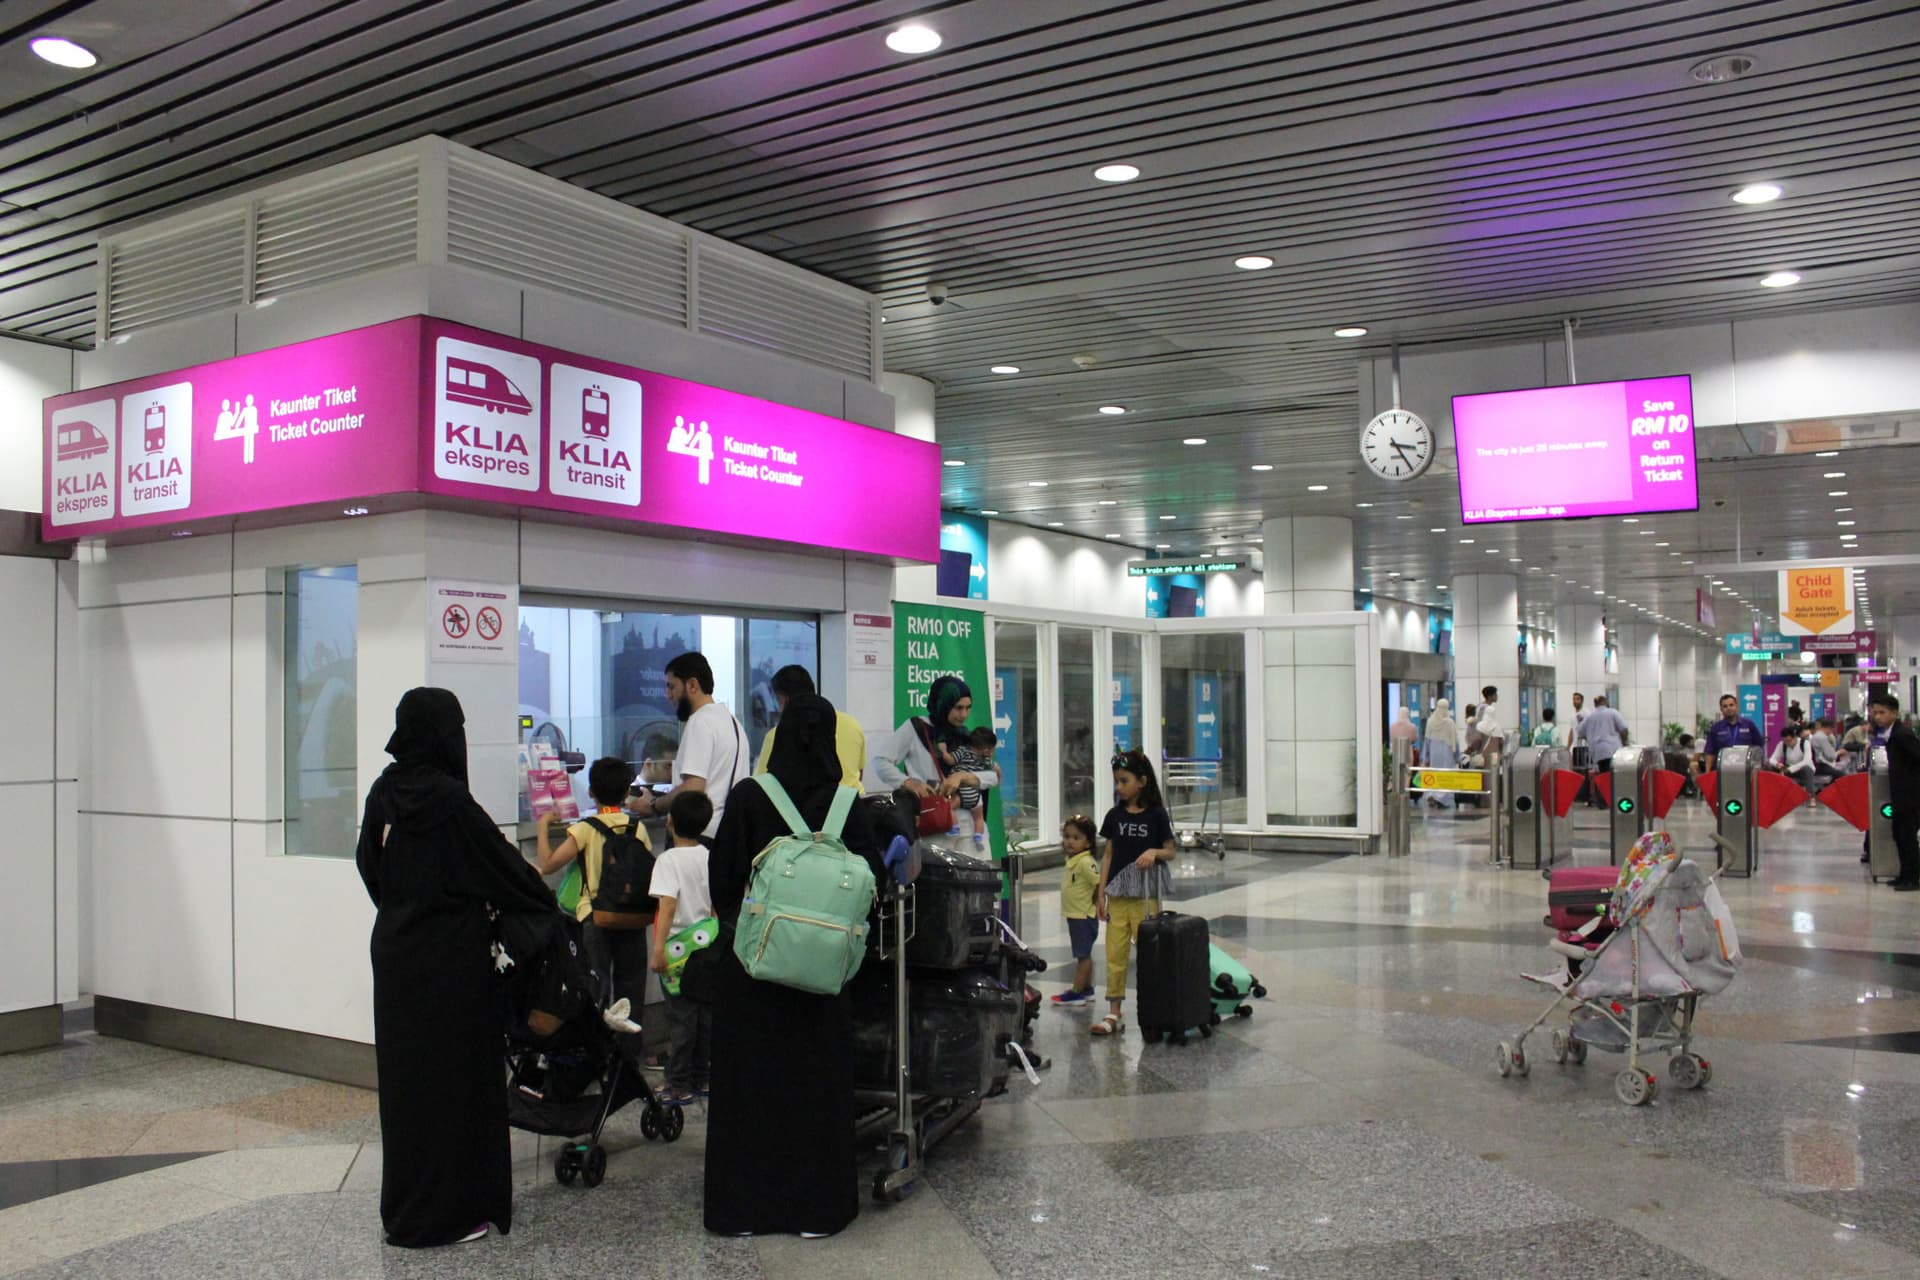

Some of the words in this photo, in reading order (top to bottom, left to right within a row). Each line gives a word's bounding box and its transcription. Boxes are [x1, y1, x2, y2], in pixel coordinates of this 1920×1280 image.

[270, 394, 321, 418] Kaunter
[323, 385, 357, 407] Tiket
[1643, 400, 1674, 413] Save
[269, 420, 308, 443] Ticket
[310, 413, 365, 435] Counter
[1631, 416, 1666, 436] RM
[1668, 414, 1689, 434] 10
[445, 421, 530, 457] KLIA
[1652, 439, 1670, 451] on
[559, 439, 632, 473] KLIA
[723, 435, 770, 459] Kaunter
[770, 445, 798, 466] Tiket
[1640, 452, 1684, 467] Return
[127, 457, 183, 484] KLIA
[445, 450, 530, 478] ekspres
[722, 457, 759, 480] Ticket
[760, 465, 804, 487] Counter
[56, 471, 108, 496] KLIA
[567, 466, 626, 491] transit
[1643, 469, 1683, 482] Ticket
[133, 480, 178, 502] transit
[56, 493, 108, 514] ekspres
[1795, 574, 1832, 587] Child
[1800, 588, 1832, 599] Gate
[907, 616, 943, 636] RM10
[947, 620, 972, 638] OFF
[907, 640, 939, 660] KLIA
[1118, 822, 1149, 838] YES
